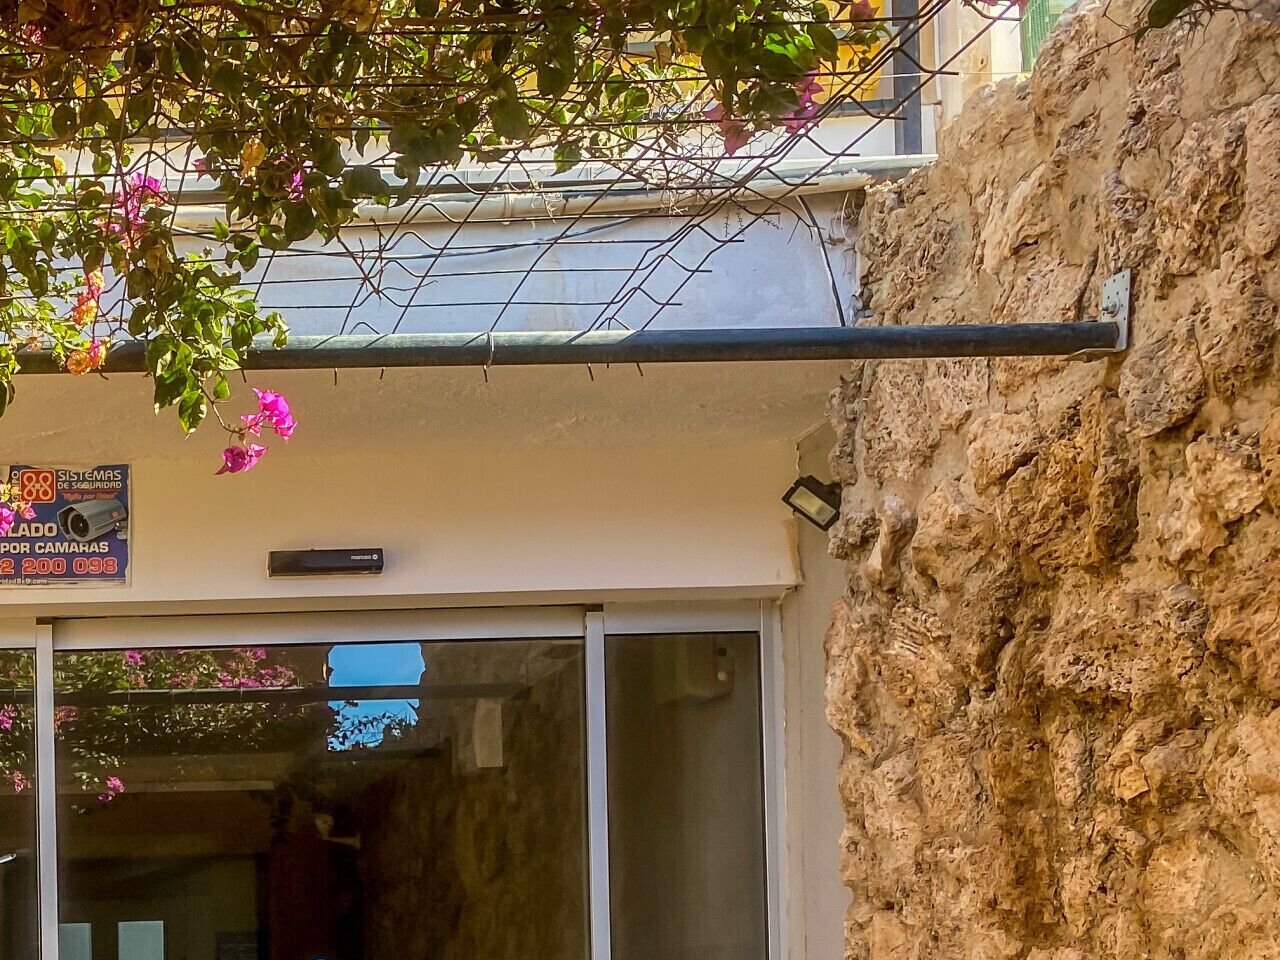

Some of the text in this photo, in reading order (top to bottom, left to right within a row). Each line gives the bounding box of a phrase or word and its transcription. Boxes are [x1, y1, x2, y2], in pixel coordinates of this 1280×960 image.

[57, 470, 122, 481] SISTEMAS
[57, 481, 122, 490] DE SEGURIDAD
[0, 541, 109, 554] POR CAMARAS
[21, 557, 67, 575] 200
[73, 557, 118, 575] 098
